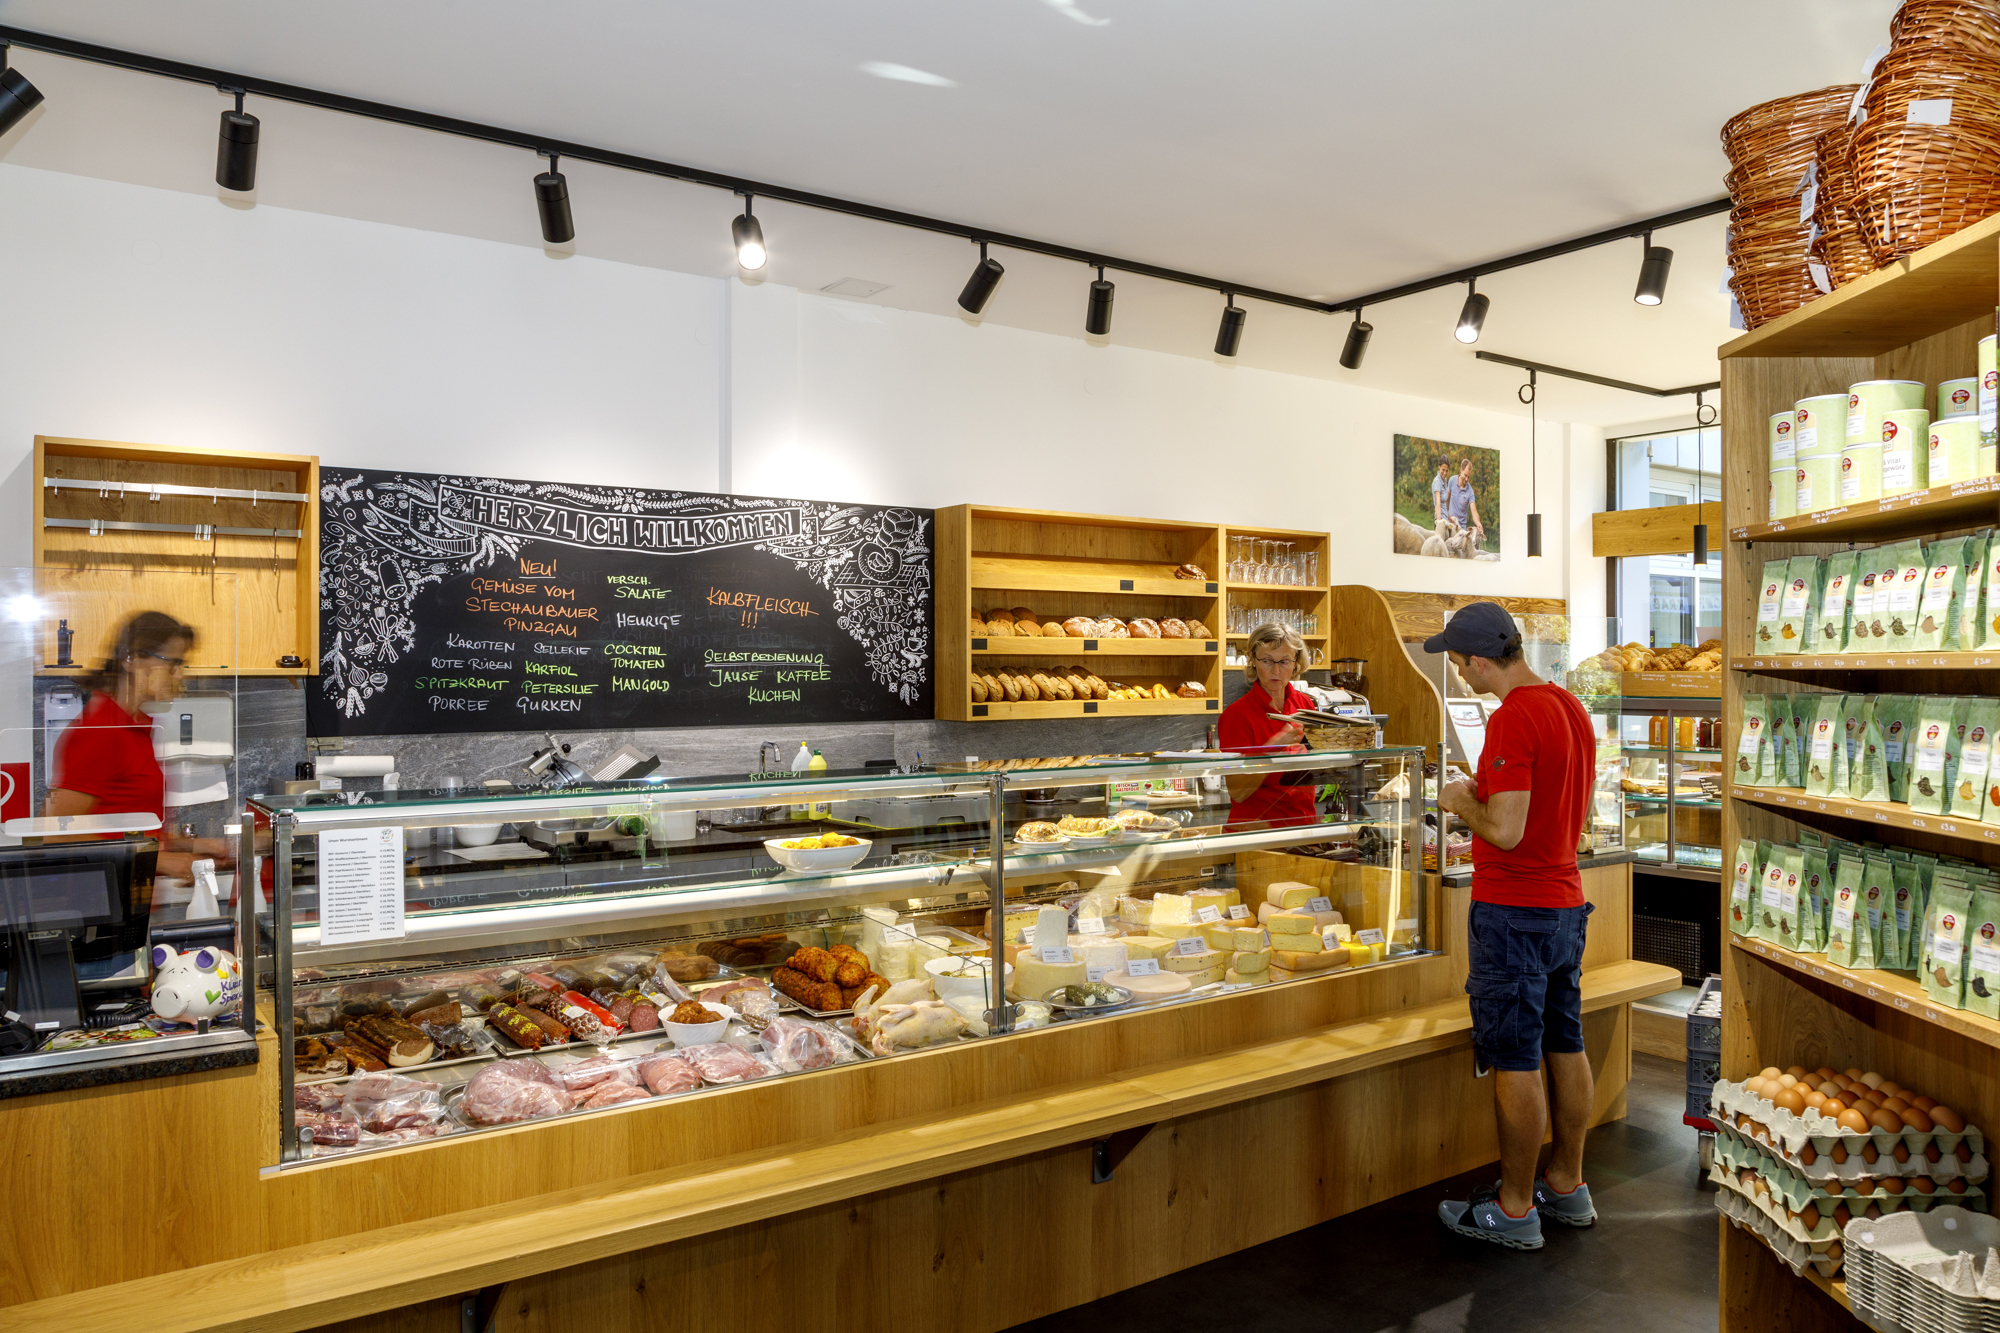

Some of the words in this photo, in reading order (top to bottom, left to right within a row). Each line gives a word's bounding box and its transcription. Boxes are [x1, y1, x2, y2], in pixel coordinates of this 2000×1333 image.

[472, 495, 628, 546] HERZLICH
[634, 511, 793, 548] WILLKOMMEN
[520, 558, 557, 577] NEU!
[471, 578, 538, 596] GEMÜSE
[543, 584, 575, 601] VOM
[613, 585, 672, 600] SALATE
[465, 597, 600, 622] STECHAUBAUER
[706, 586, 820, 617] KALBFLEISCH
[503, 617, 578, 638] PINZGAU
[616, 612, 683, 629] HEURIGE
[446, 632, 516, 652] KAROTTEN
[533, 642, 592, 656] SELLERIE
[604, 643, 668, 657] COCKTAIL
[431, 657, 465, 670] ROTE
[468, 657, 513, 671] RÜBEN
[610, 656, 665, 670] TOMATEN
[703, 648, 825, 667] SELBSTBEDIENUNG
[524, 660, 578, 677] KARFIOL
[414, 676, 510, 692] SPITZKRAUT
[612, 676, 670, 693] MANGOLD
[709, 669, 763, 688] JAUSE
[776, 669, 832, 684] KAFFEE
[520, 680, 600, 695] PETERSILIE
[748, 686, 801, 705] KUCHEN
[428, 695, 490, 712] PORREE
[515, 696, 582, 713] GURKEN
